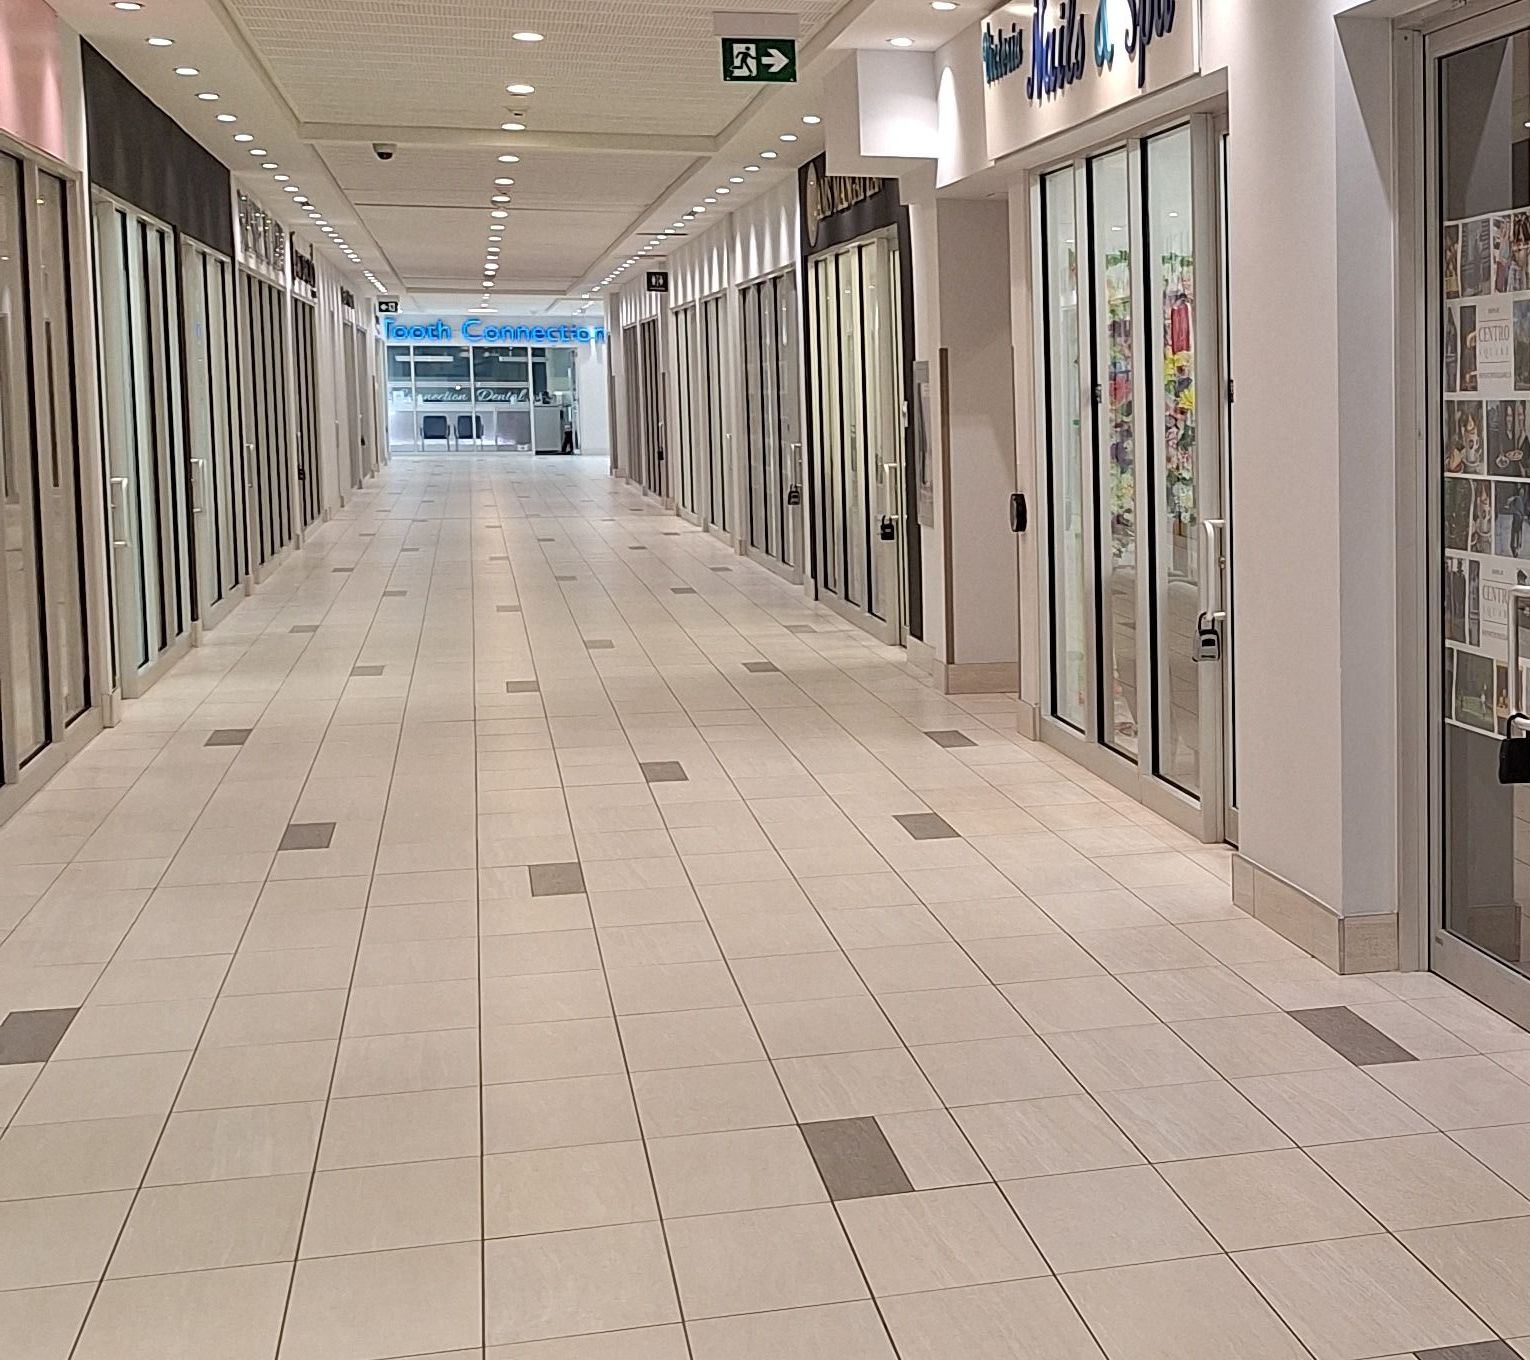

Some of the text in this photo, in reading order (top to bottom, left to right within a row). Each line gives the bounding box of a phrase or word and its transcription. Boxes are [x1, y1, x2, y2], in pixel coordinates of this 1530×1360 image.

[383, 316, 606, 343] Tooth Connection
[1483, 584, 1509, 604] CENTR
